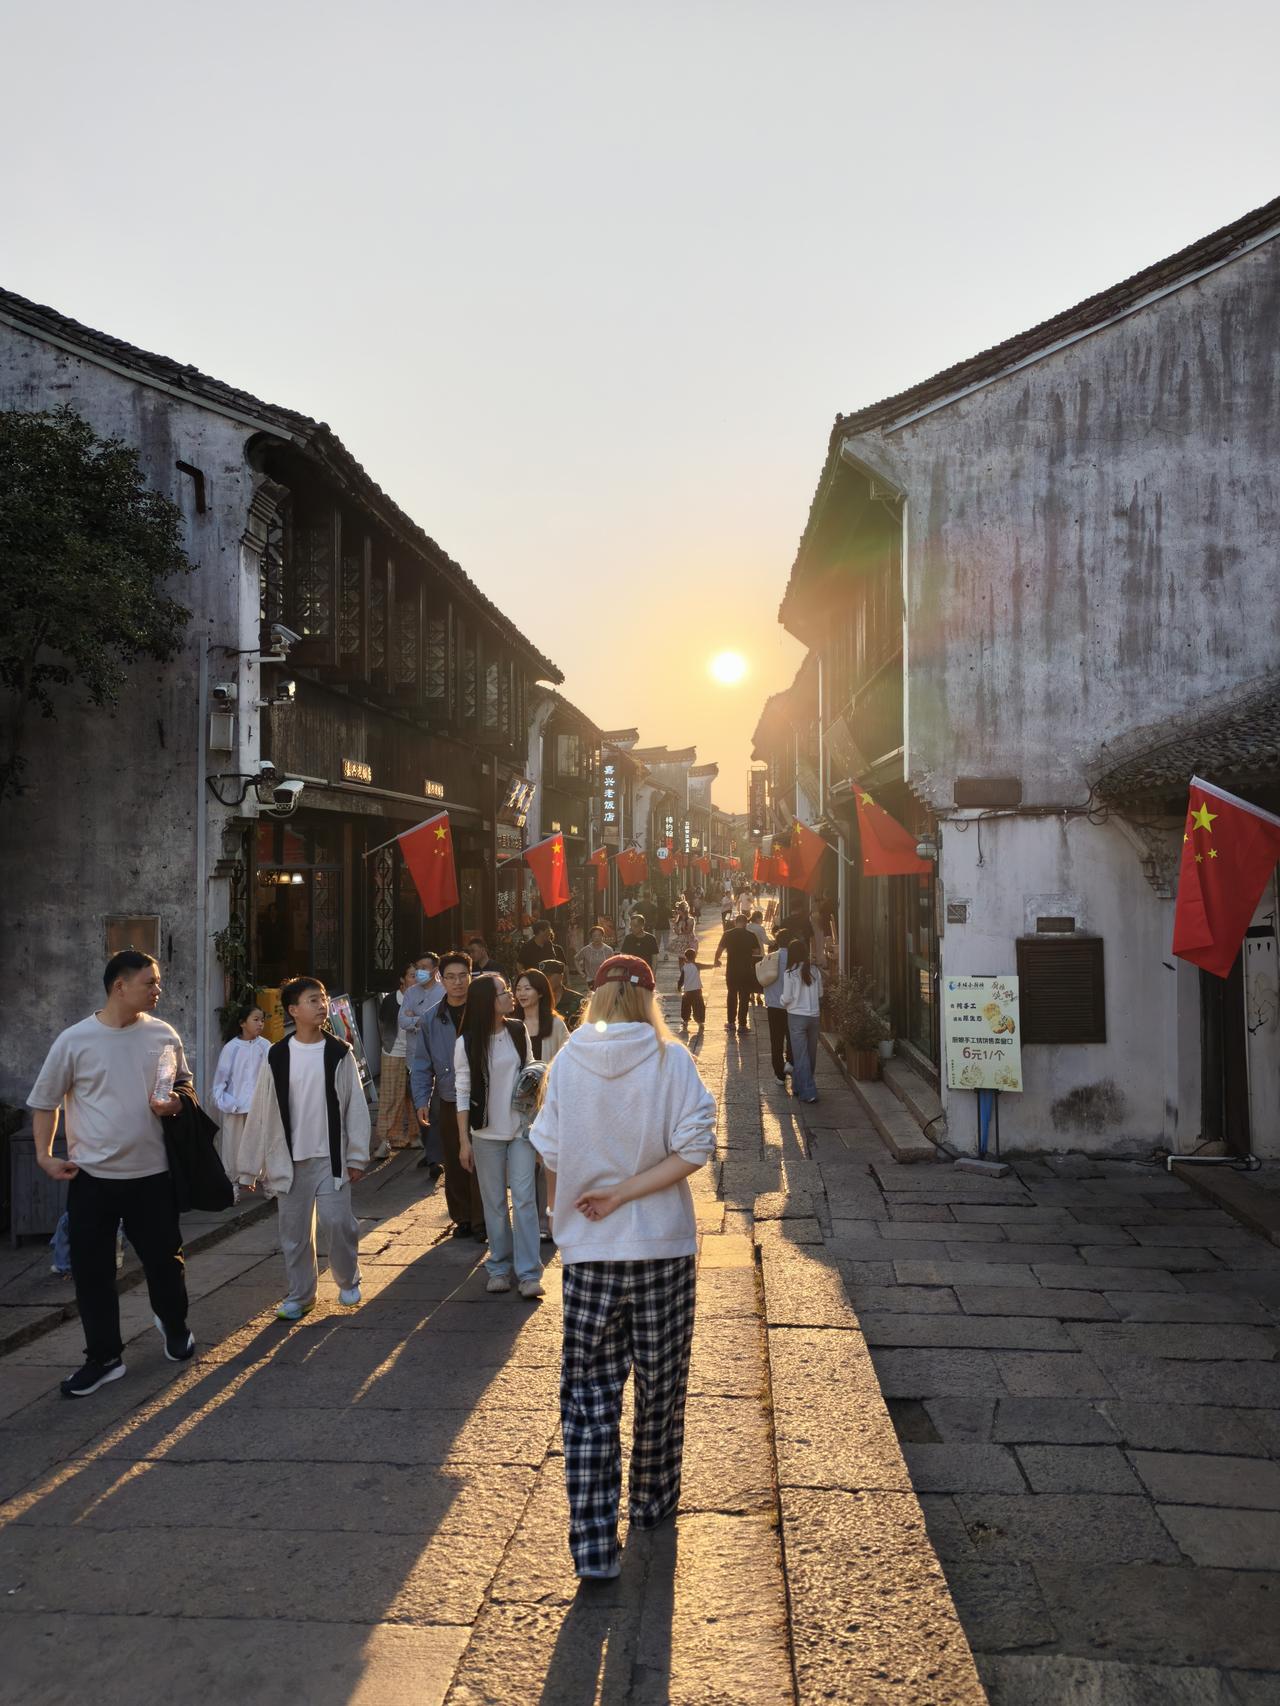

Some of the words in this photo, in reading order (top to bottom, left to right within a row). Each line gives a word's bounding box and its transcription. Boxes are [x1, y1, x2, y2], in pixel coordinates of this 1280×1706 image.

[603, 765, 615, 822] 嘉兴老饭店
[962, 1046, 1006, 1061] 6元1/个
